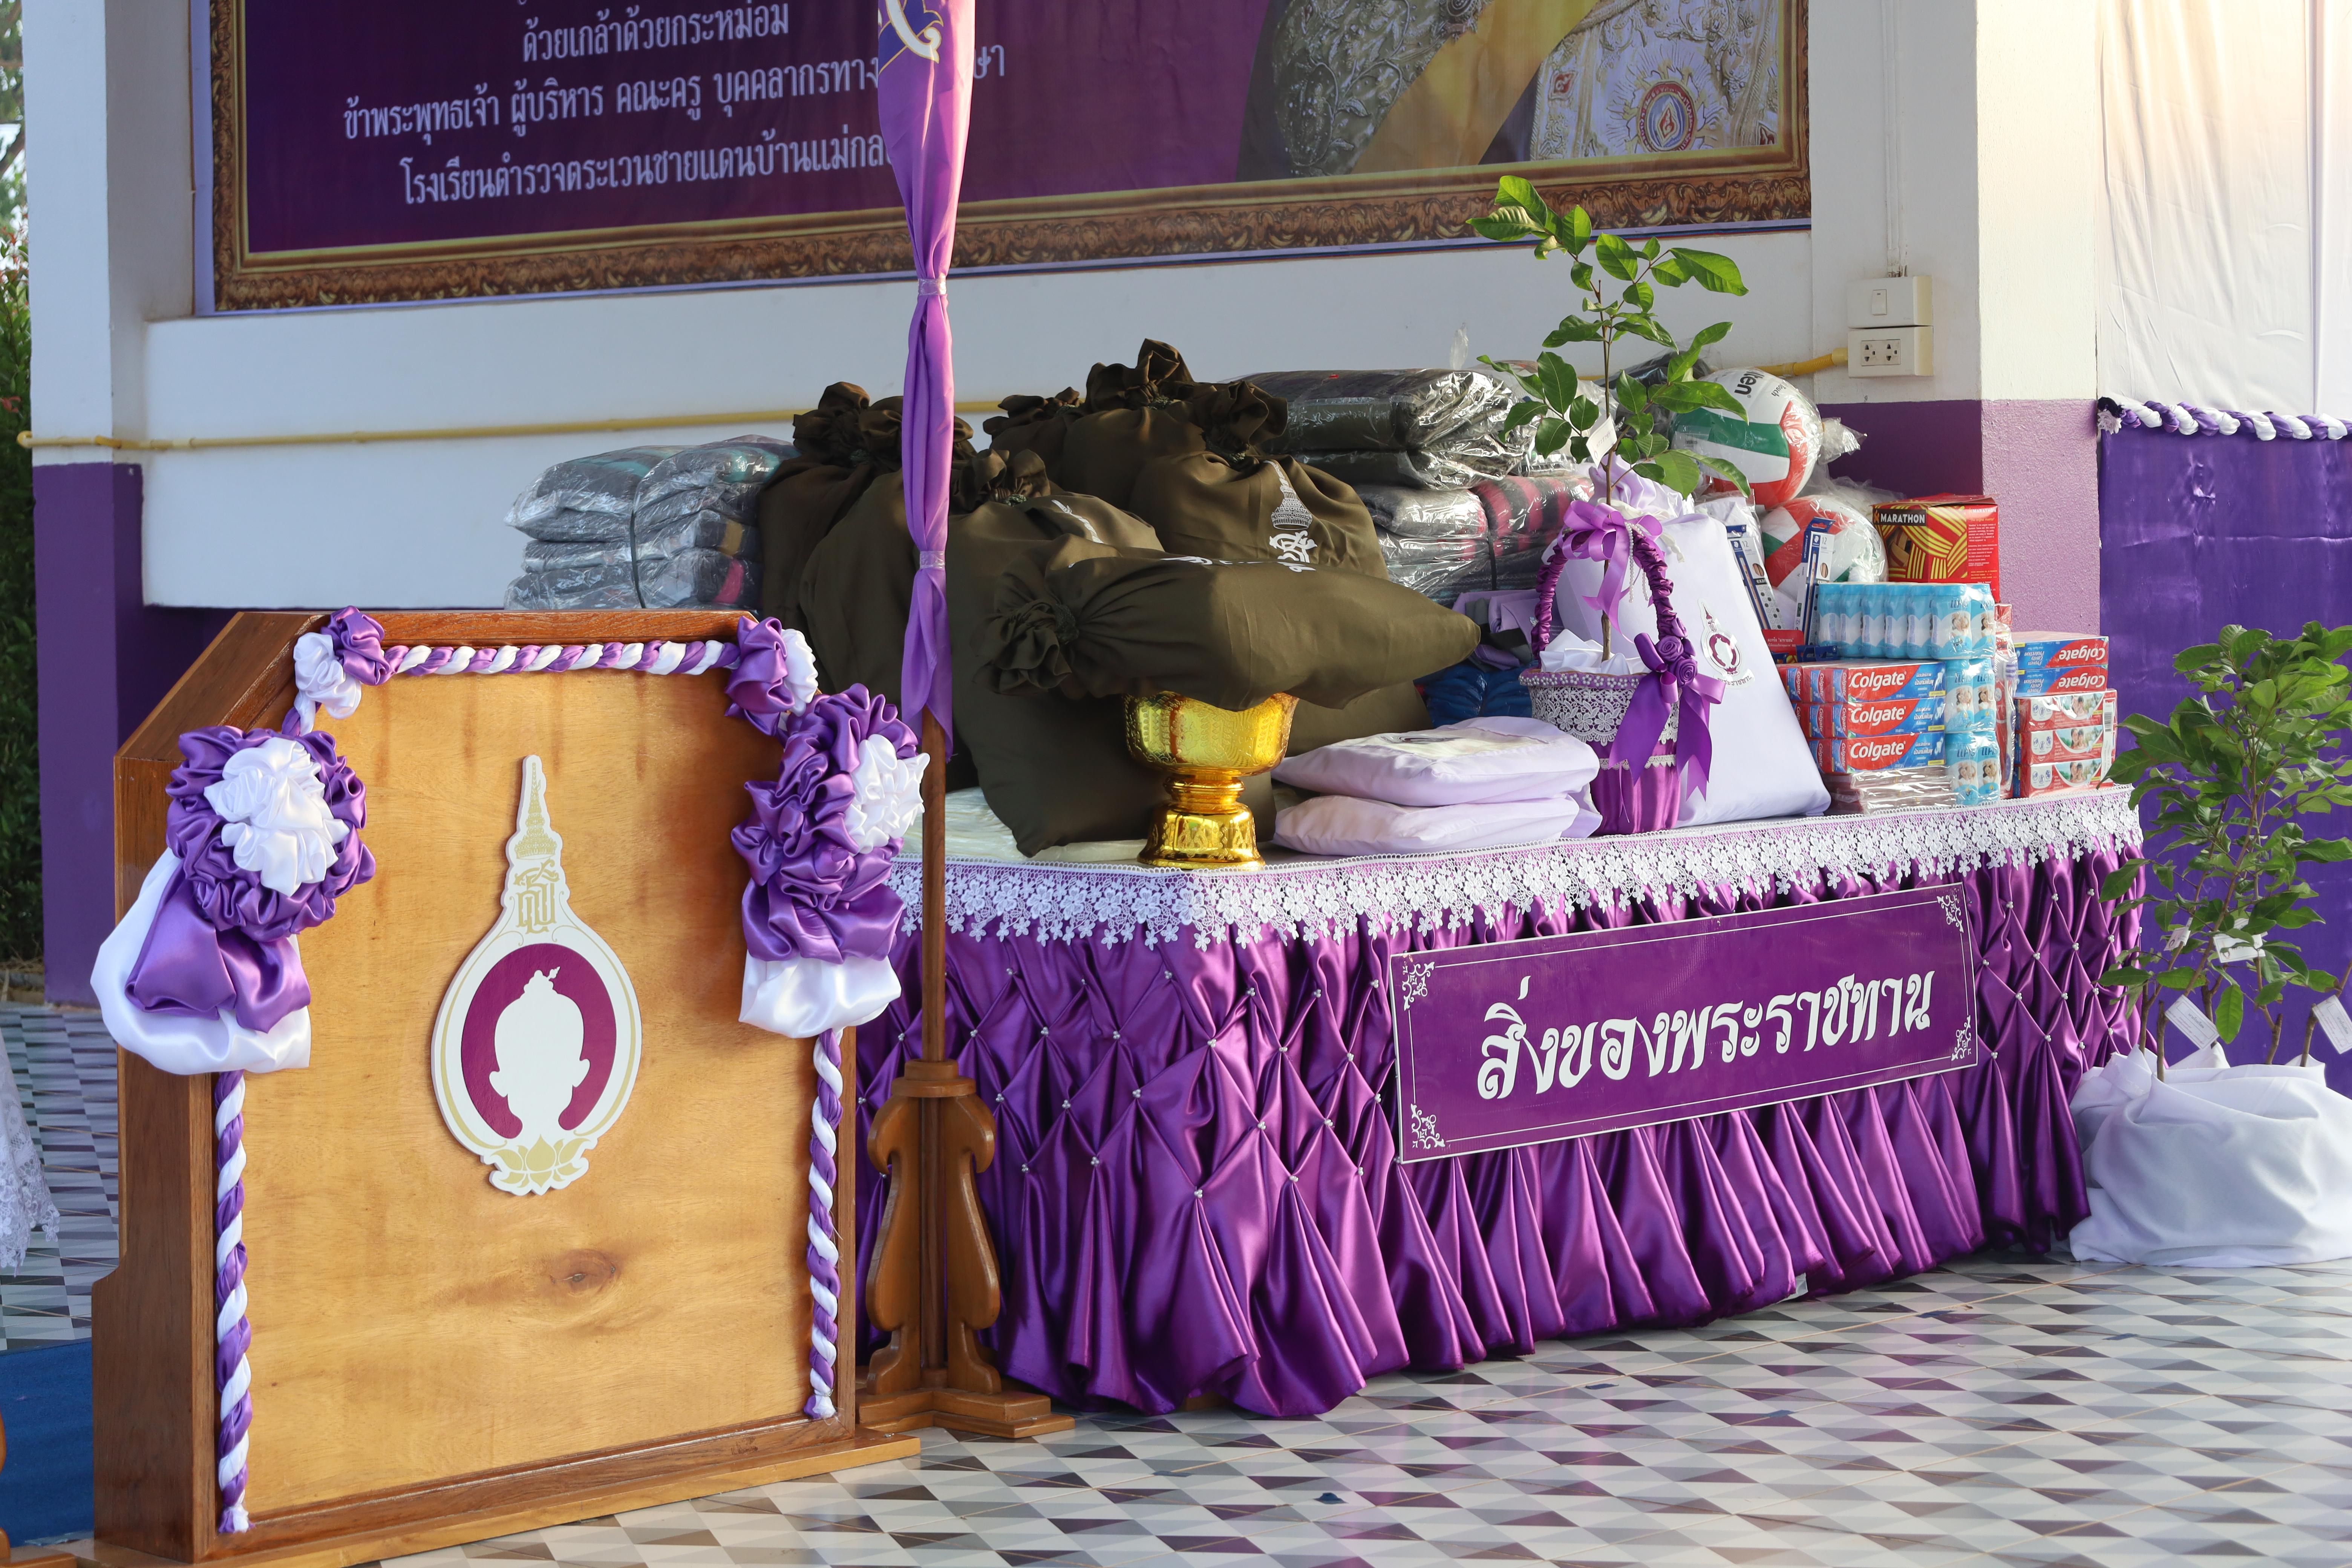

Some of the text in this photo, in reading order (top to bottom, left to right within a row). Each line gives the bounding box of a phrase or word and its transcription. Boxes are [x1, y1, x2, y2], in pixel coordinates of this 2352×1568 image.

[344, 83, 499, 145] ข้าพระพุทธเจ้า
[511, 77, 603, 137] ผู้บริหาร
[616, 75, 701, 121] คณะครู
[399, 124, 893, 204] โรงเรียนตำรวจตระเวนชายแดนบ้านแม่กล
[1734, 371, 1766, 395] lten
[1771, 384, 1787, 397] Touch
[1880, 513, 1925, 524] MARATHON
[2059, 645, 2105, 662] Colgate
[1851, 672, 1905, 691] Colgate
[2058, 672, 2105, 689] Colgate
[1851, 707, 1905, 726] Colgate
[1850, 742, 1905, 761] Colgate
[1477, 970, 1936, 1100] สิ่งของพระราชทาน
